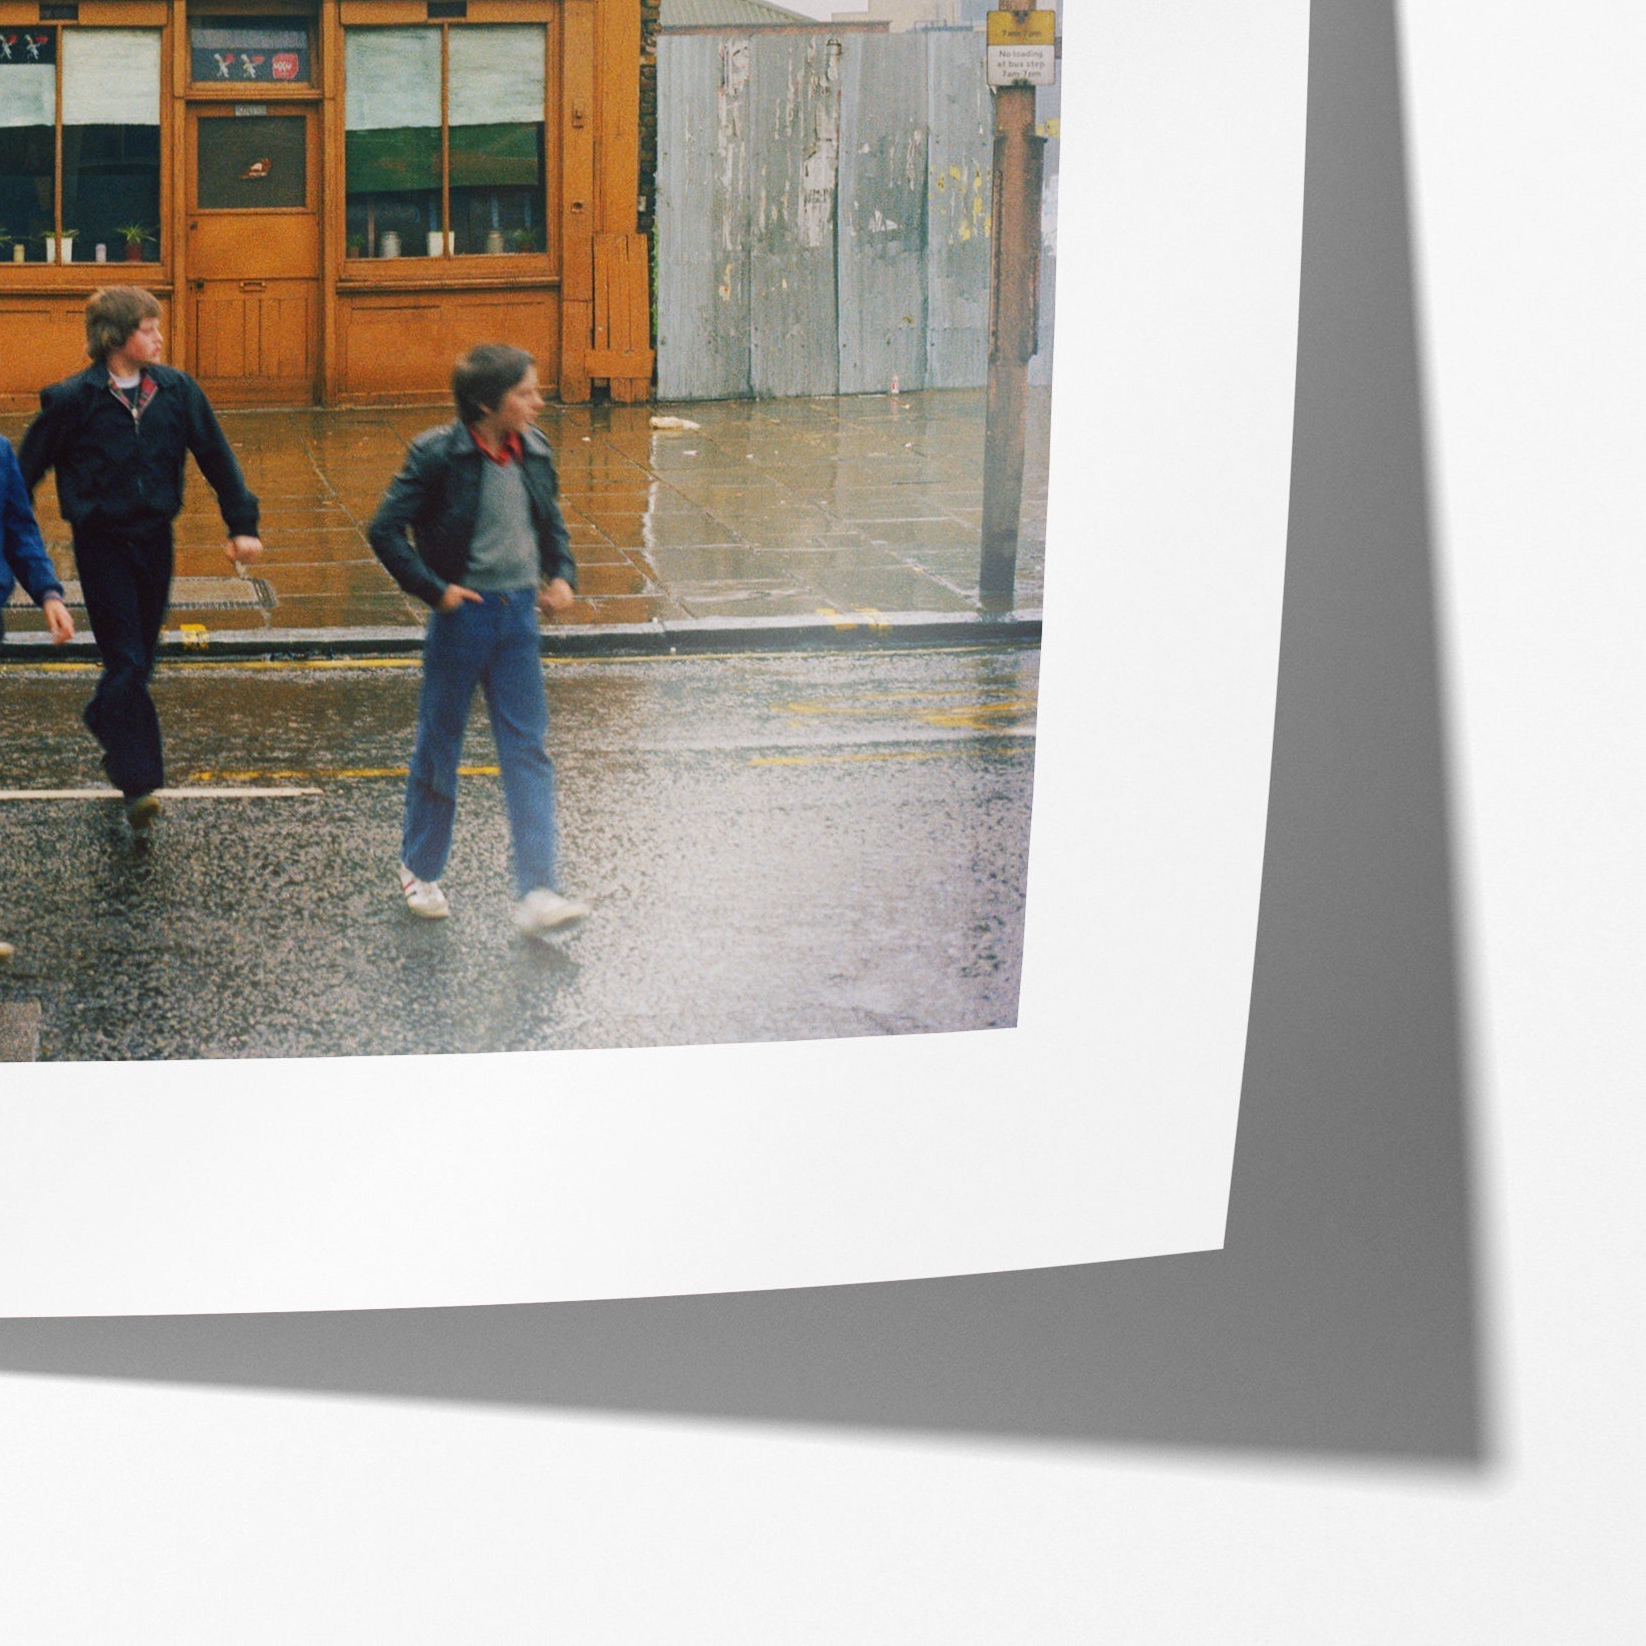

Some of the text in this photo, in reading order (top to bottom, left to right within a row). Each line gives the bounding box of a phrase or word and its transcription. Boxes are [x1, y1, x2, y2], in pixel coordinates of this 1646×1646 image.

[999, 50, 1043, 59] No loading
[997, 60, 1006, 68] at
[1026, 60, 1046, 68] stop
